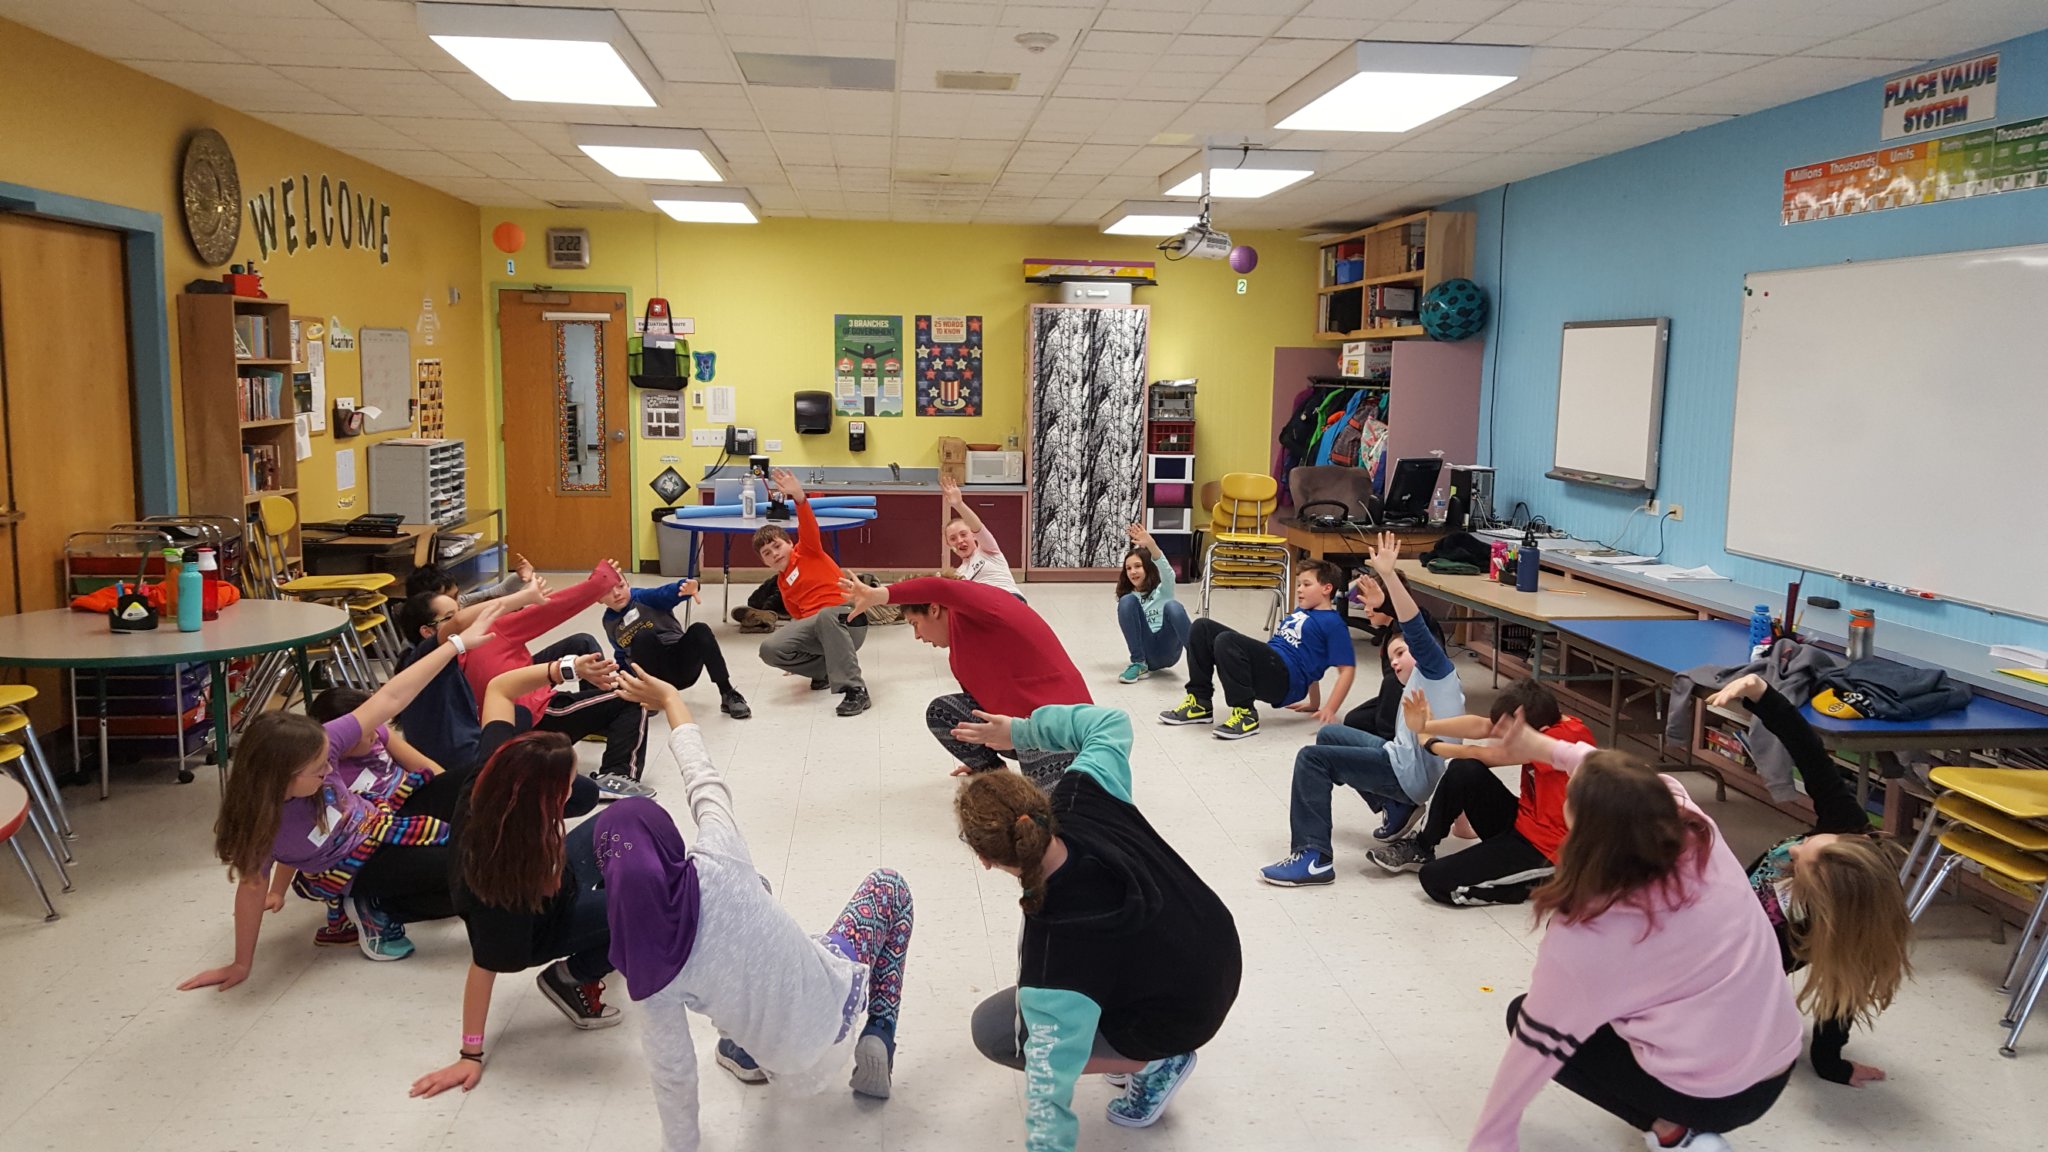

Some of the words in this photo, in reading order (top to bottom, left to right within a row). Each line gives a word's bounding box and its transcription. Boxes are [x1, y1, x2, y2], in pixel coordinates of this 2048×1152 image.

[1884, 71, 1938, 109] PLACE
[1941, 56, 1998, 94] VALUE
[1904, 95, 1968, 133] SYSTEM
[1790, 167, 1823, 183] Millions
[1829, 156, 1877, 175] Thousands
[1890, 148, 1915, 163] Units
[249, 174, 391, 265] WELCOME
[508, 261, 514, 273] 1
[1239, 281, 1246, 292] 2
[848, 319, 853, 328] 3
[854, 319, 889, 328] BRANCHES
[934, 320, 942, 328] 25
[943, 320, 964, 328] WORDS
[851, 327, 895, 336] GOVERNMENT
